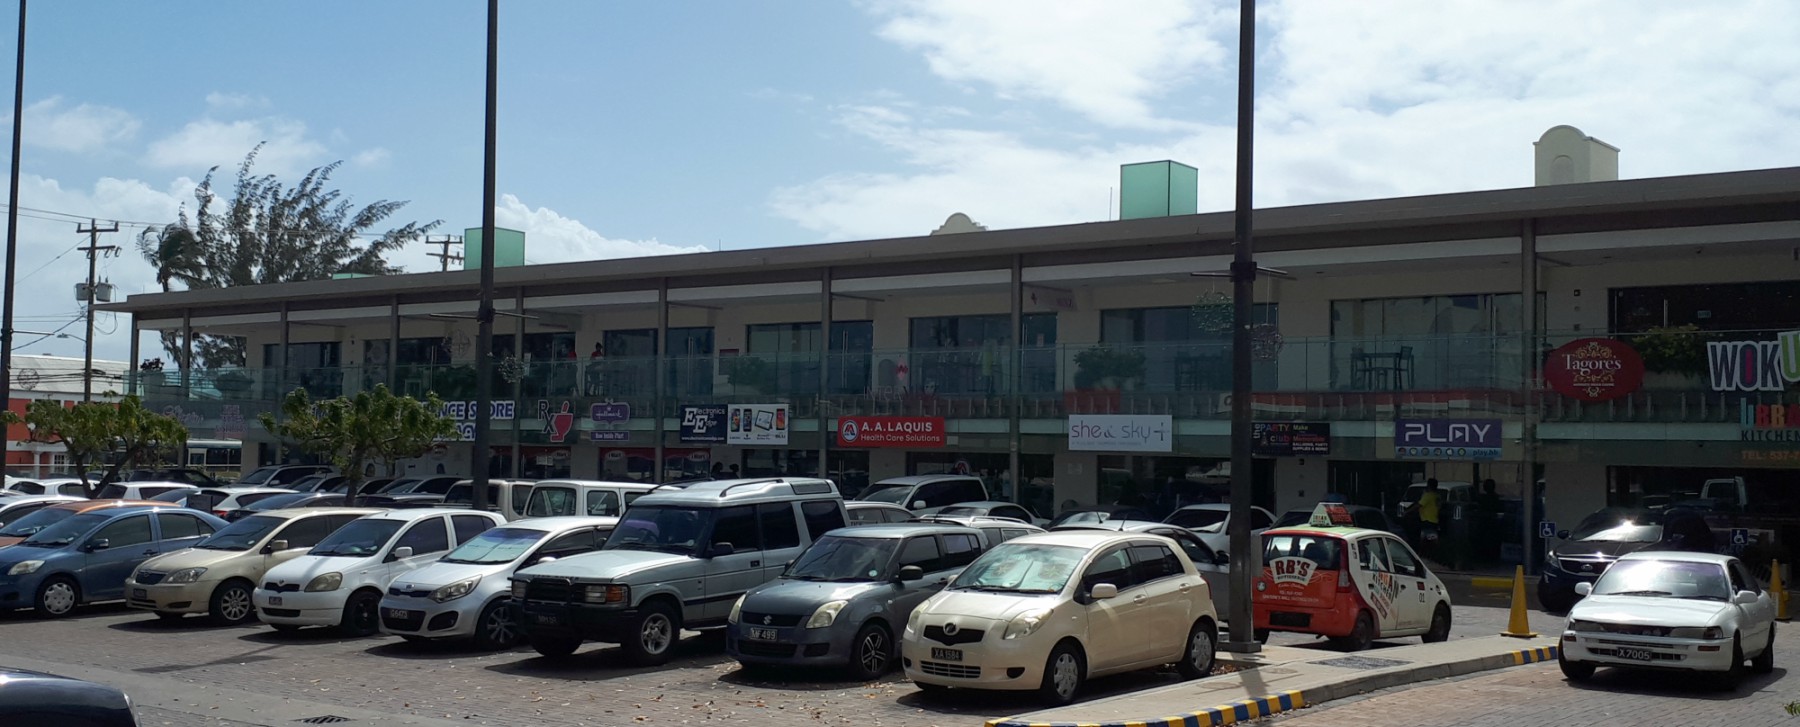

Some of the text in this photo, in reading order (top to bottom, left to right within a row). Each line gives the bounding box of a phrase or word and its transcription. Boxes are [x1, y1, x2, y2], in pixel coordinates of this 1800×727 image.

[1562, 353, 1622, 376] Tagore's
[905, 435, 940, 443] Solutions
[1405, 423, 1491, 443] PLAY
[1275, 560, 1310, 577] RB'S
